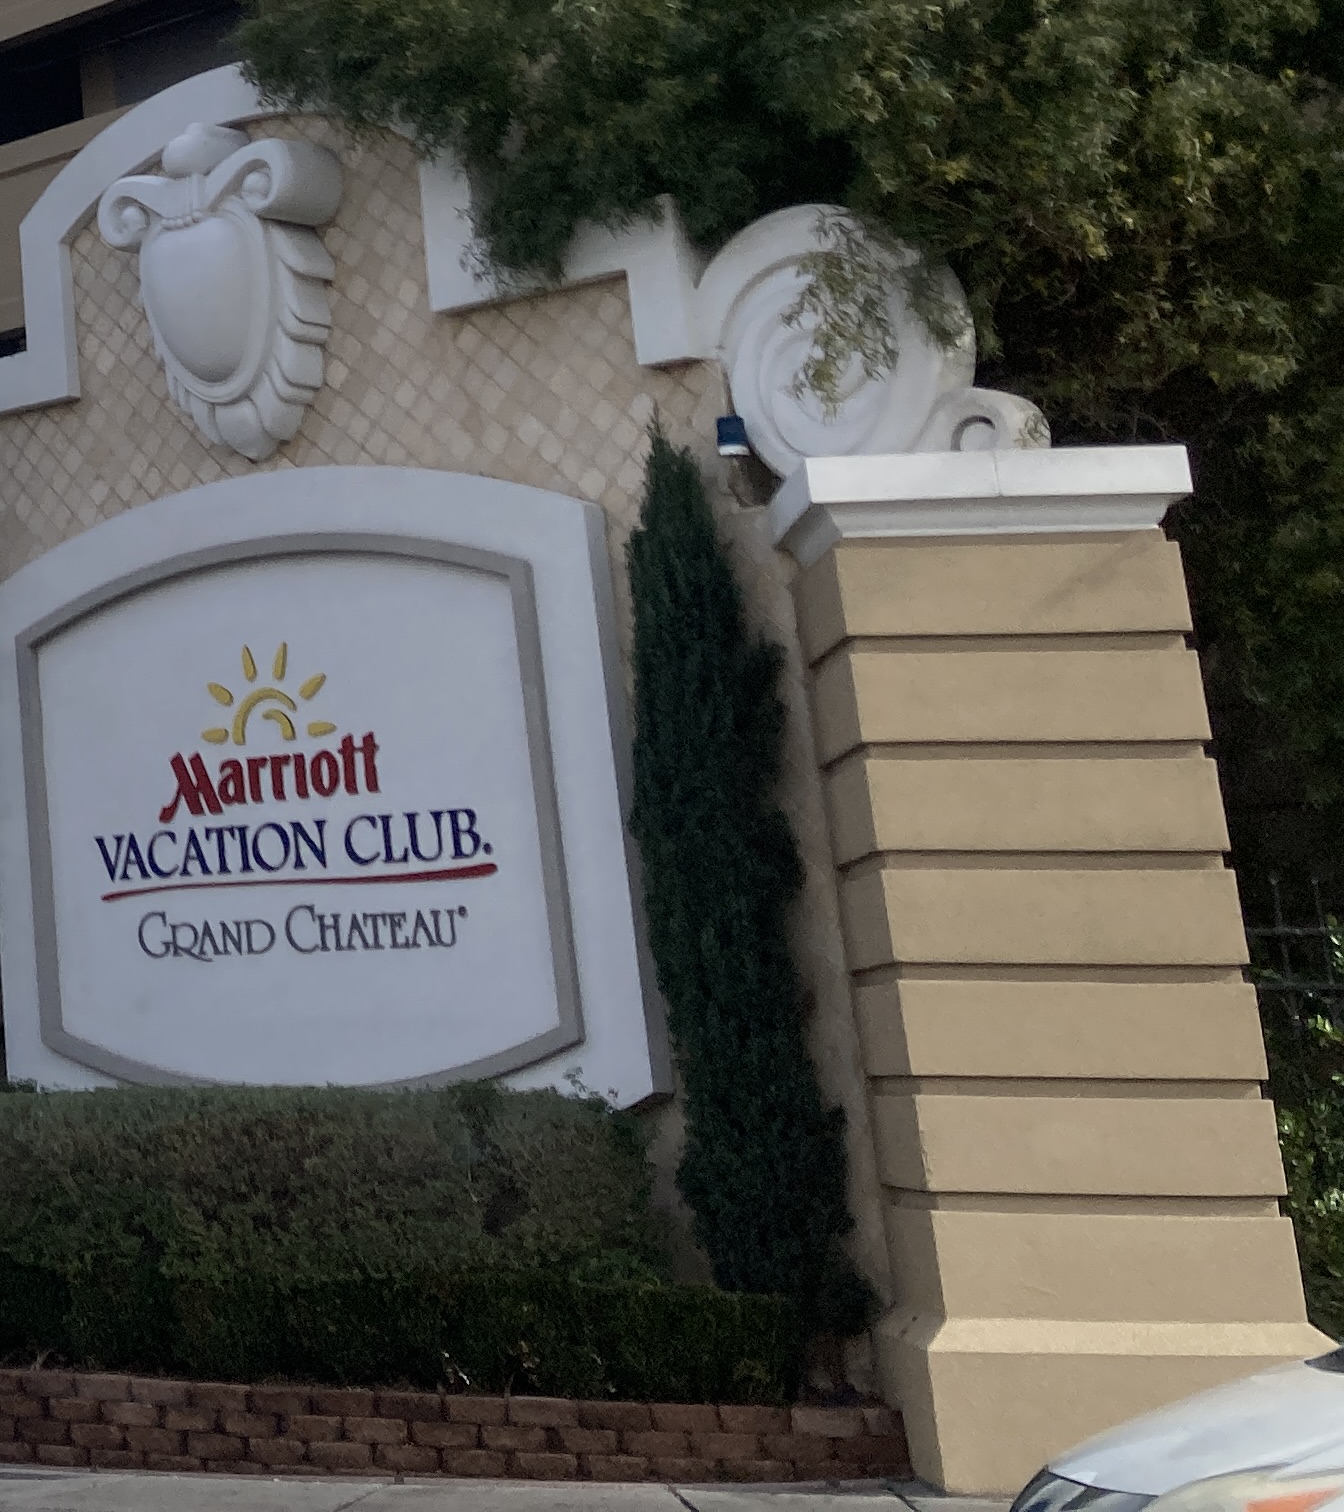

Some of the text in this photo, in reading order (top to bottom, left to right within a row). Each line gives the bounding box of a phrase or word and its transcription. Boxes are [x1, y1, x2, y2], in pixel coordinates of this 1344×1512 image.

[158, 731, 382, 824] Marriott
[93, 819, 327, 884] VACATION
[138, 910, 275, 963] GRAND
